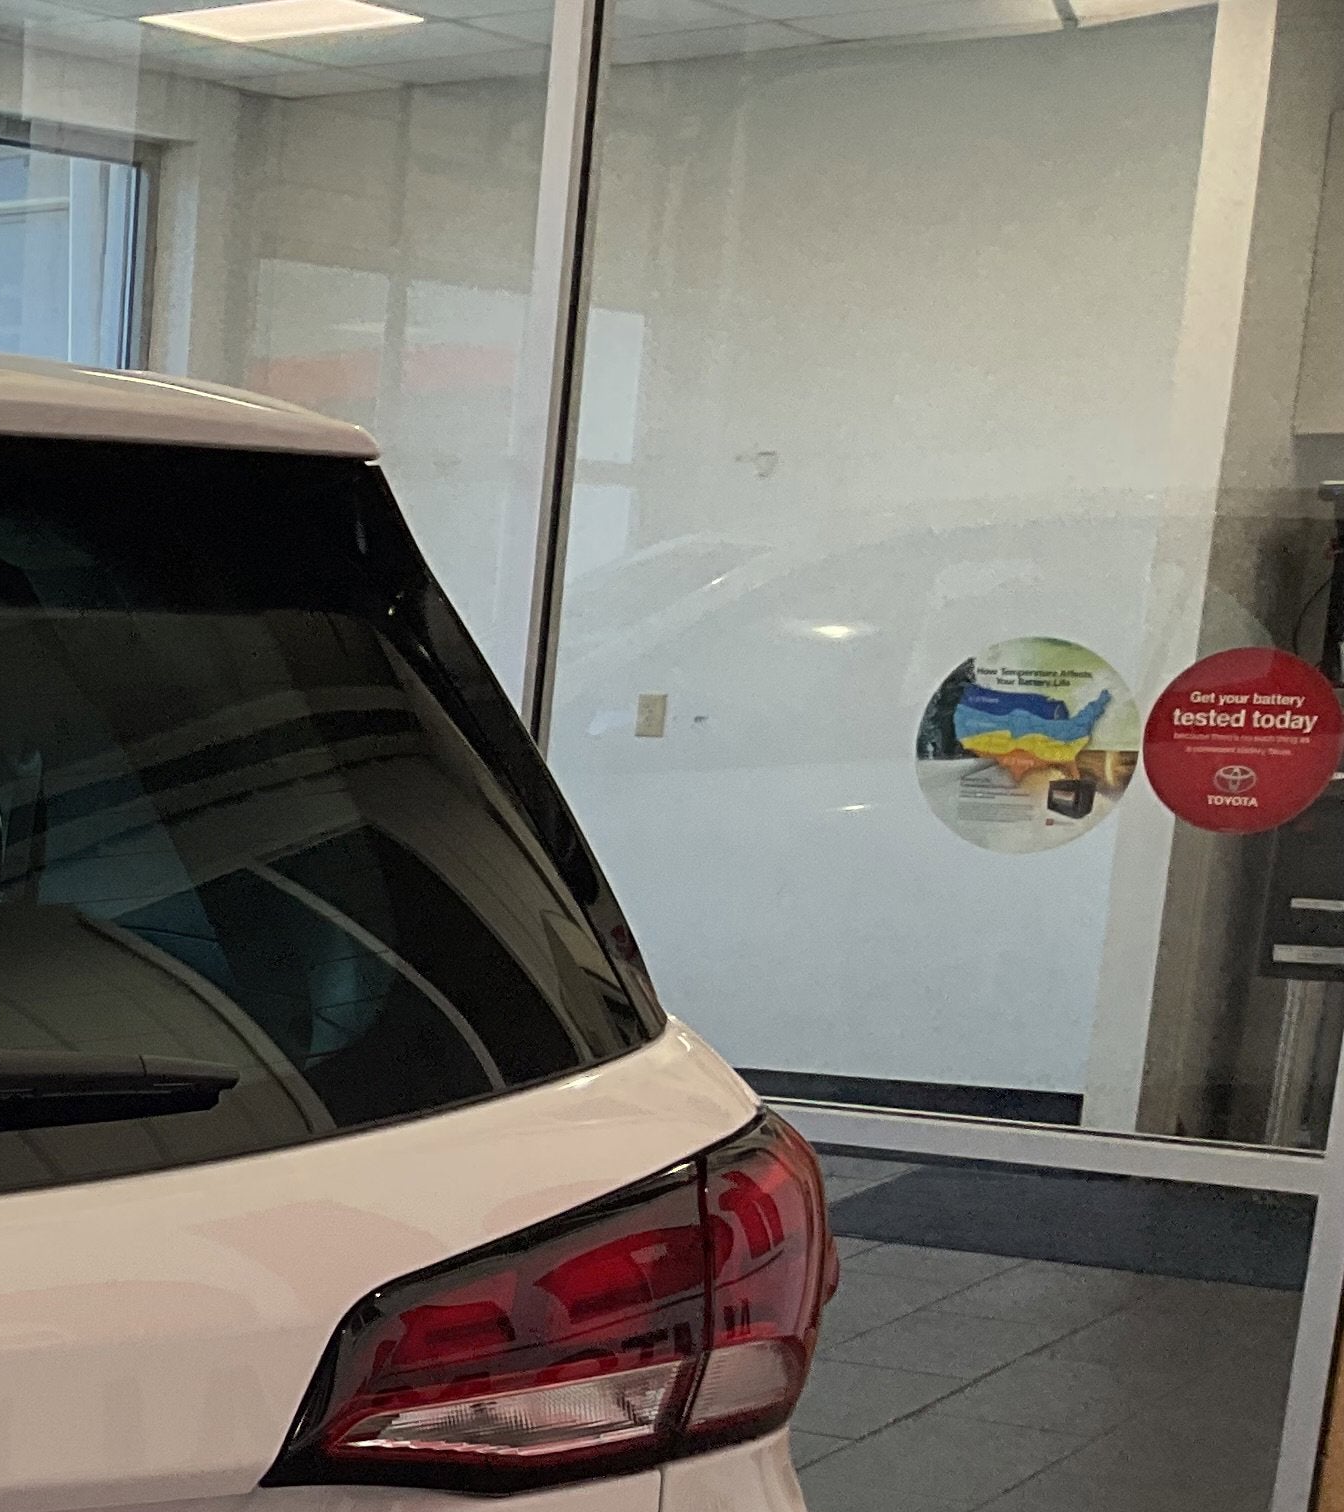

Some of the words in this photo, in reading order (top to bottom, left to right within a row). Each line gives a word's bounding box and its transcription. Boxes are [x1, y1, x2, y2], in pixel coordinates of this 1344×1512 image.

[1189, 691, 1215, 705] Get
[1219, 694, 1249, 706] your
[1253, 692, 1305, 709] battery
[1172, 708, 1247, 728] tested
[1252, 710, 1319, 733] today
[1207, 795, 1259, 808] TOYOTA
